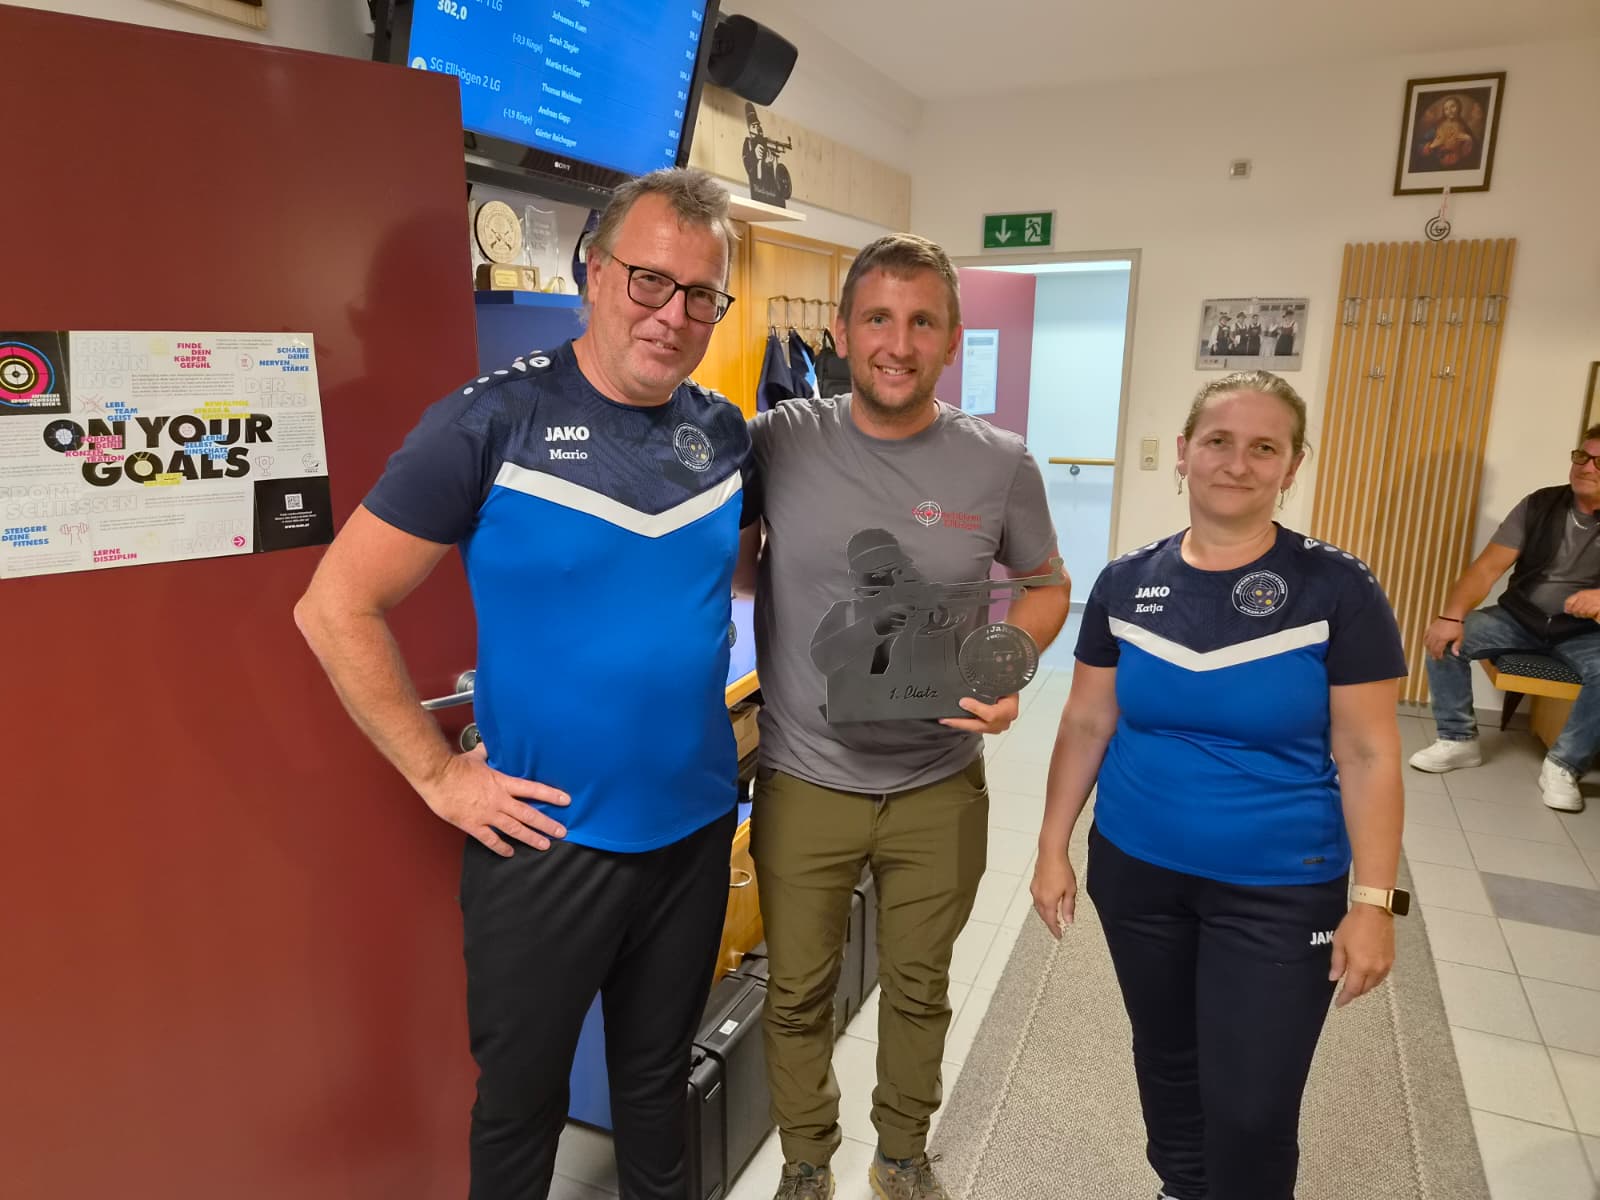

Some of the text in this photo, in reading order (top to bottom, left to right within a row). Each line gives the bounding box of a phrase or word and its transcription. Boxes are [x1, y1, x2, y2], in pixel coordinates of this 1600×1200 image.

[437, 0, 468, 20] 302,0
[430, 56, 443, 72] SG
[482, 75, 489, 88] 2
[490, 77, 501, 92] LG
[177, 342, 202, 350] FINDE
[277, 345, 310, 354] SCHÄRFE
[282, 365, 310, 373] STÄRKE
[43, 419, 126, 453] ON
[135, 413, 274, 449] YOUR
[545, 426, 590, 441] JAKO
[549, 449, 588, 460] Mario
[82, 446, 252, 487] GOALS
[4, 525, 48, 534] STEIGERE
[13, 538, 49, 547] FITNESS
[93, 553, 137, 563] DISZIPLIN
[1135, 586, 1170, 599] JAKO
[1135, 603, 1164, 614] Katja
[889, 684, 938, 700] 1. Platz
[1309, 931, 1334, 945] JAK
